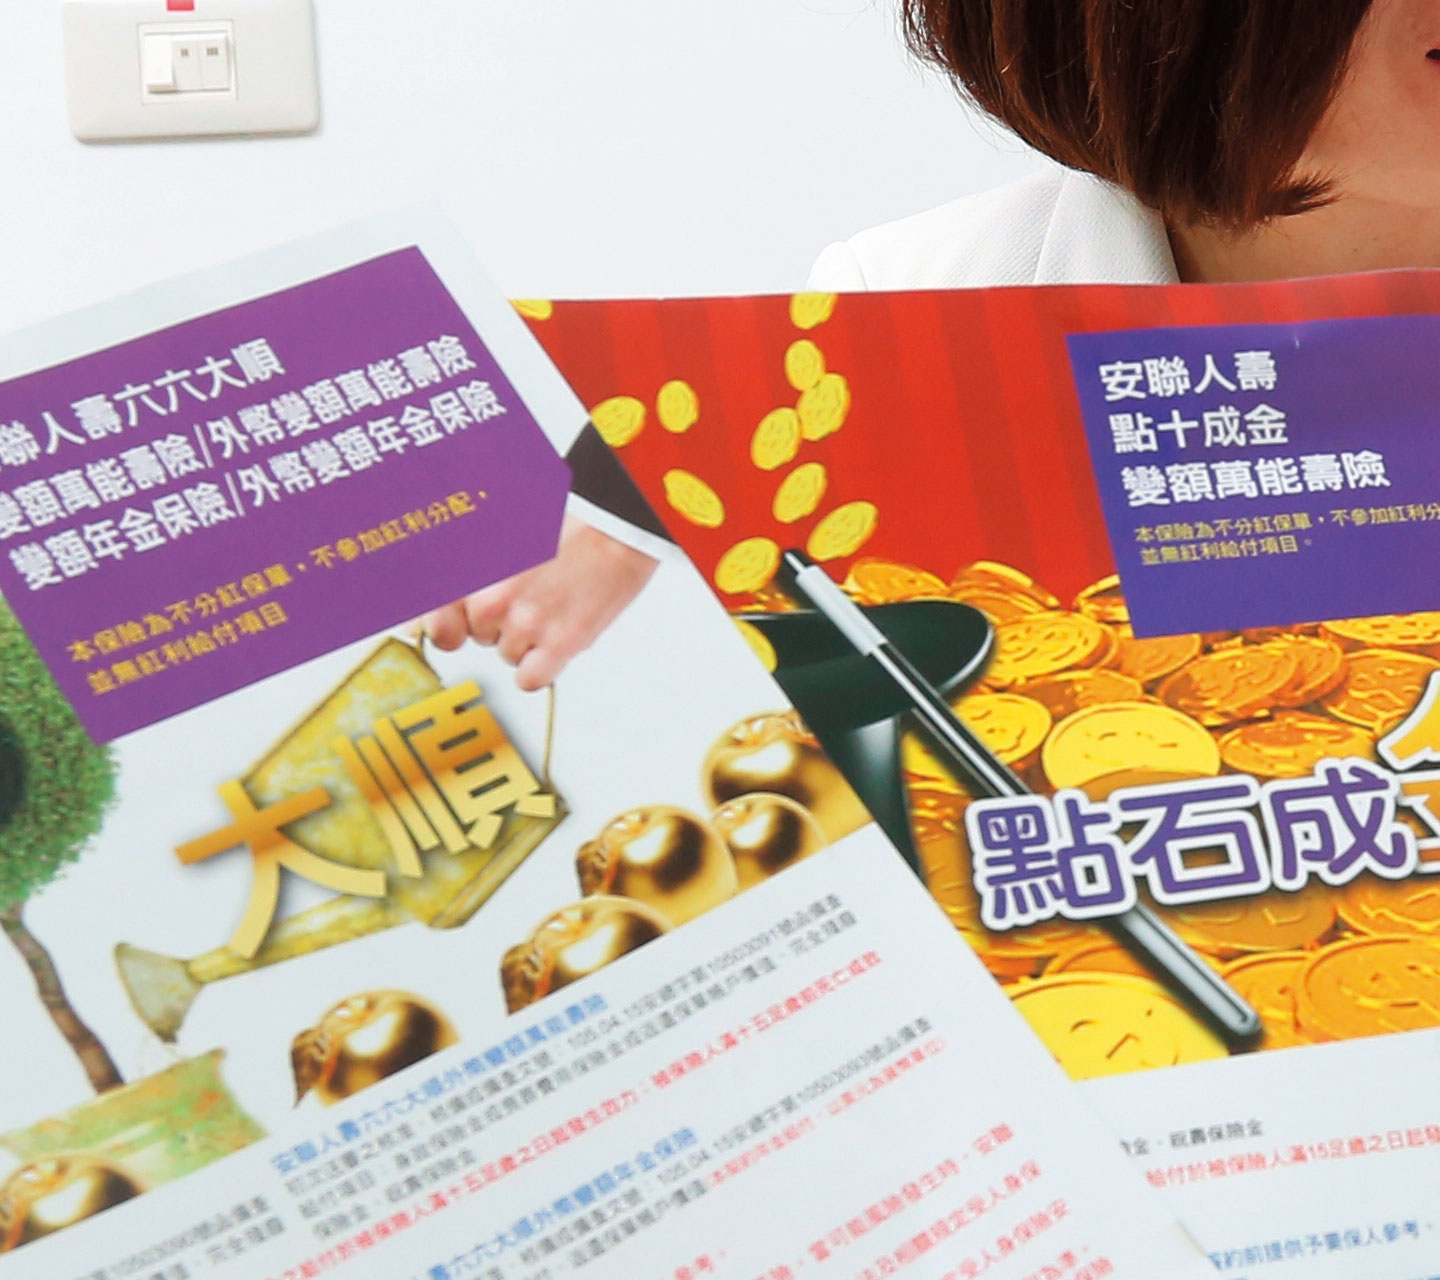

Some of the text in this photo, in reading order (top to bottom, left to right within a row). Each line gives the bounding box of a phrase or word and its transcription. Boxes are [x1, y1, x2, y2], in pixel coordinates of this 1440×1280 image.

[1098, 349, 1279, 402] 安聯人壽
[1108, 402, 1289, 454] 點十成金
[1120, 449, 1392, 508] 變額萬能壽險
[172, 680, 557, 959] 大順
[1118, 1118, 1265, 1158] 金、祝壽保險金
